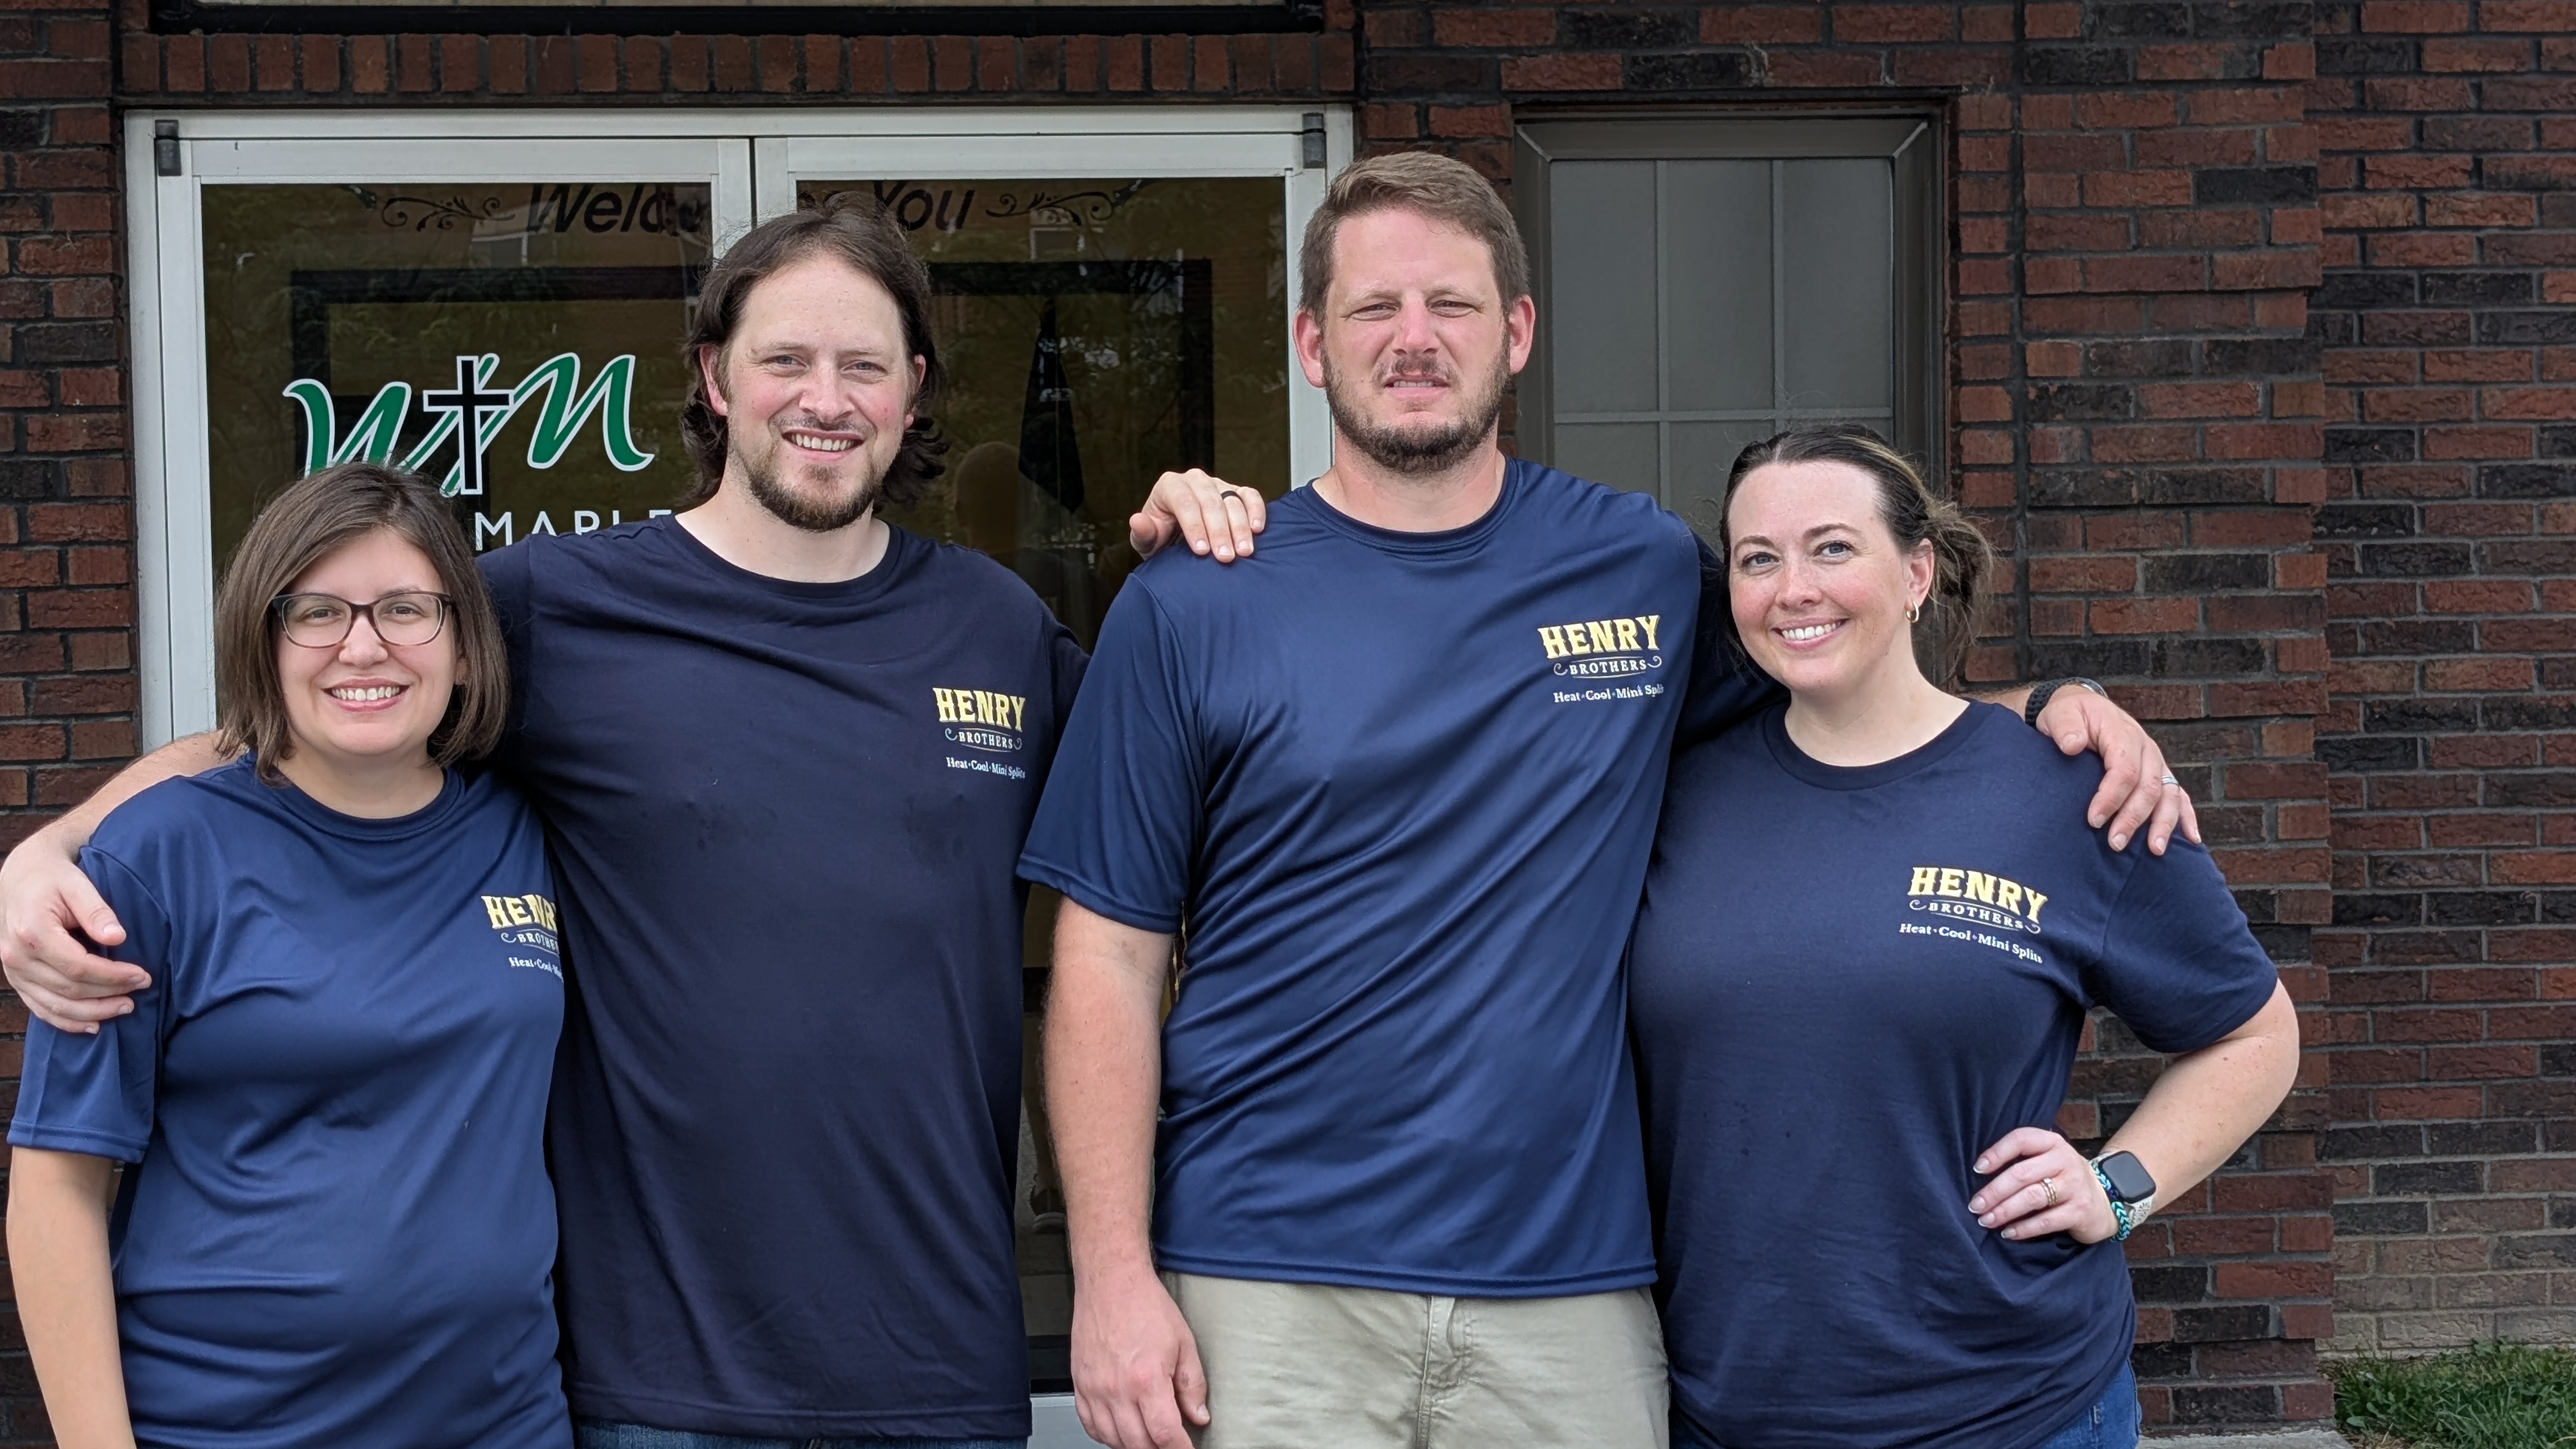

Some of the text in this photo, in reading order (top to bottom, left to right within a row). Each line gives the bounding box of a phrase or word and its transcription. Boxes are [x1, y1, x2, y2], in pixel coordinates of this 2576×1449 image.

[873, 180, 975, 231] You
[1537, 615, 1660, 659] HENRY
[1569, 659, 1647, 675] BROTHERS
[932, 687, 1025, 732] HENRY
[958, 732, 1013, 749] BROTHERS
[481, 894, 558, 935] HENR
[1907, 867, 2048, 924] HENRY
[1928, 902, 2023, 929] BROTHERS
[517, 932, 560, 952] BROTHE
